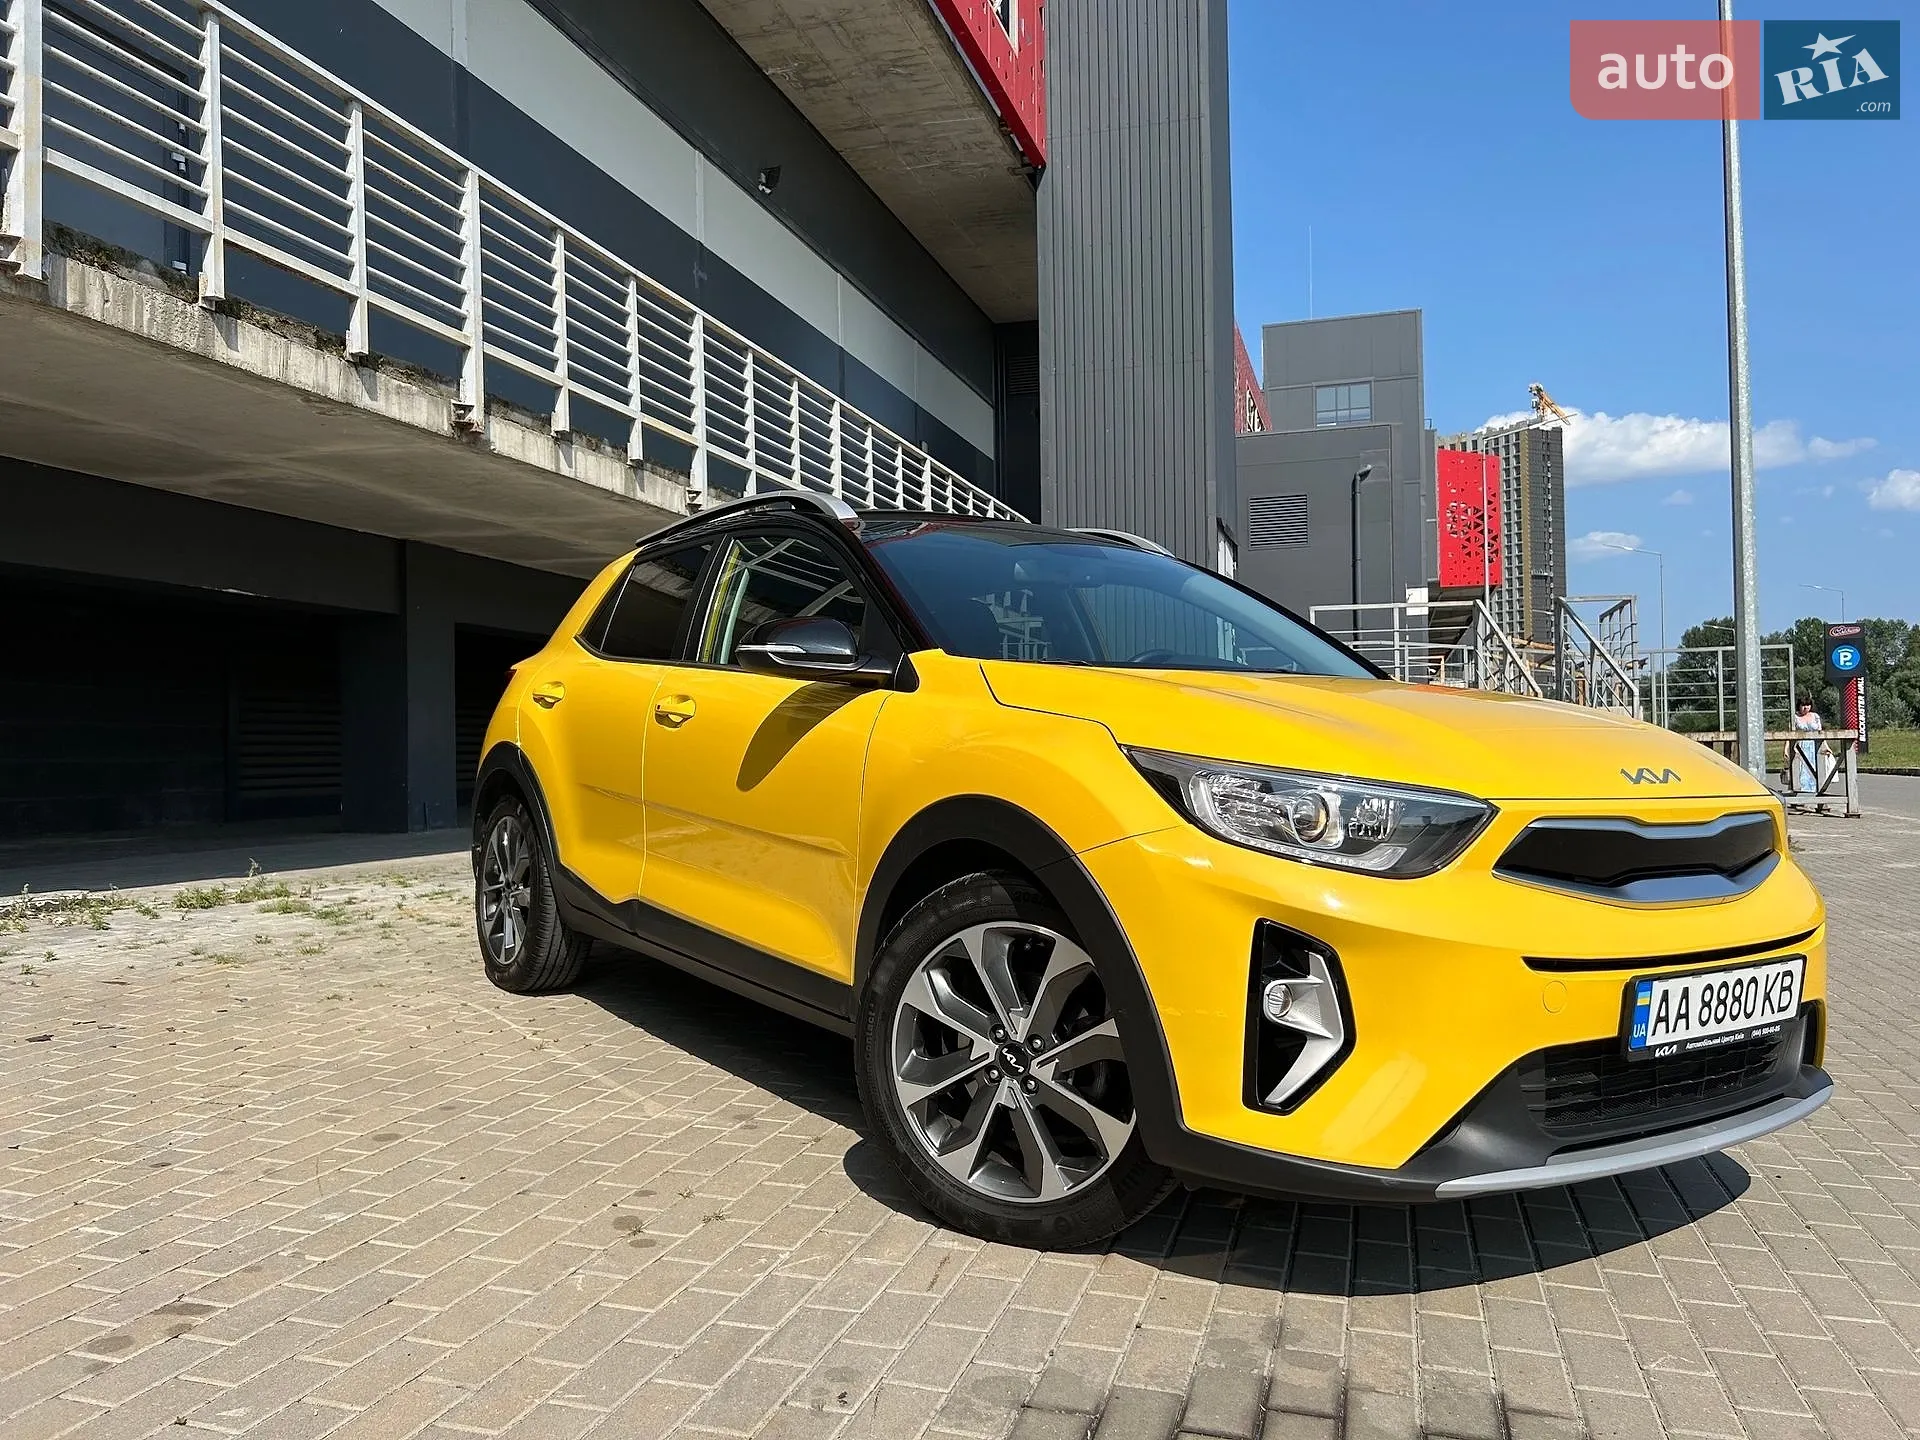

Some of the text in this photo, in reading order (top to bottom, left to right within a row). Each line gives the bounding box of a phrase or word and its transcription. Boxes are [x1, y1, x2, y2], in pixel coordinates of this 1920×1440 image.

[1858, 696, 1867, 742] BLOCKBUSTER
[1651, 969, 1794, 1037] AA 8880 KB
[1633, 1024, 1647, 1039] UA
